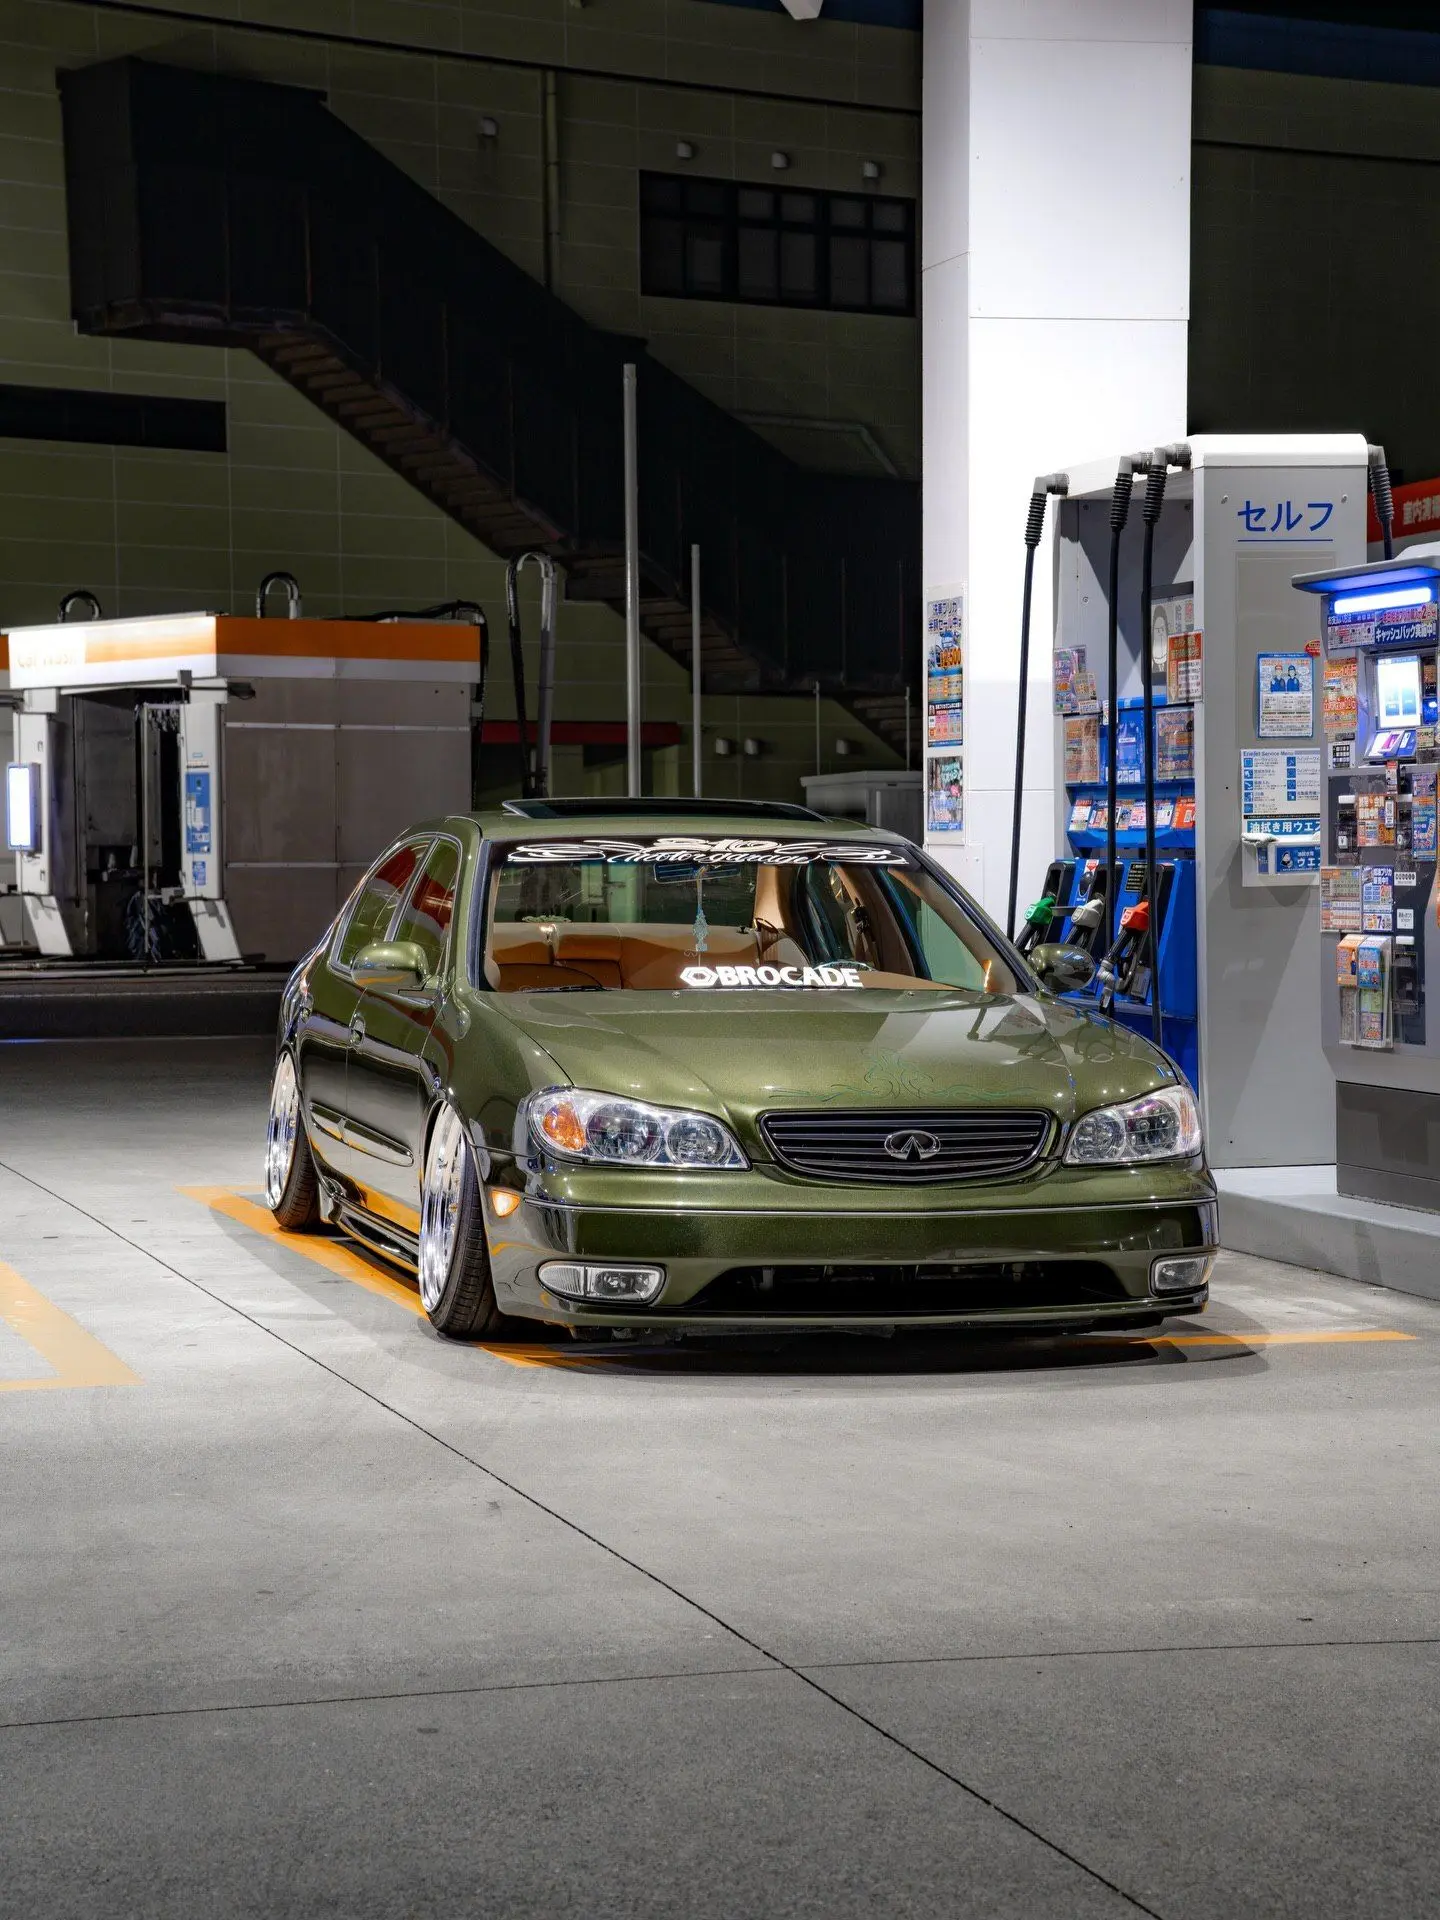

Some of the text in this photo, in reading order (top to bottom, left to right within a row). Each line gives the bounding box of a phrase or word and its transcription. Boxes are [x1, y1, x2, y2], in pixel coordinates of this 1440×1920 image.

[1238, 501, 1333, 531] セルフ
[716, 966, 863, 988] BROCADE
